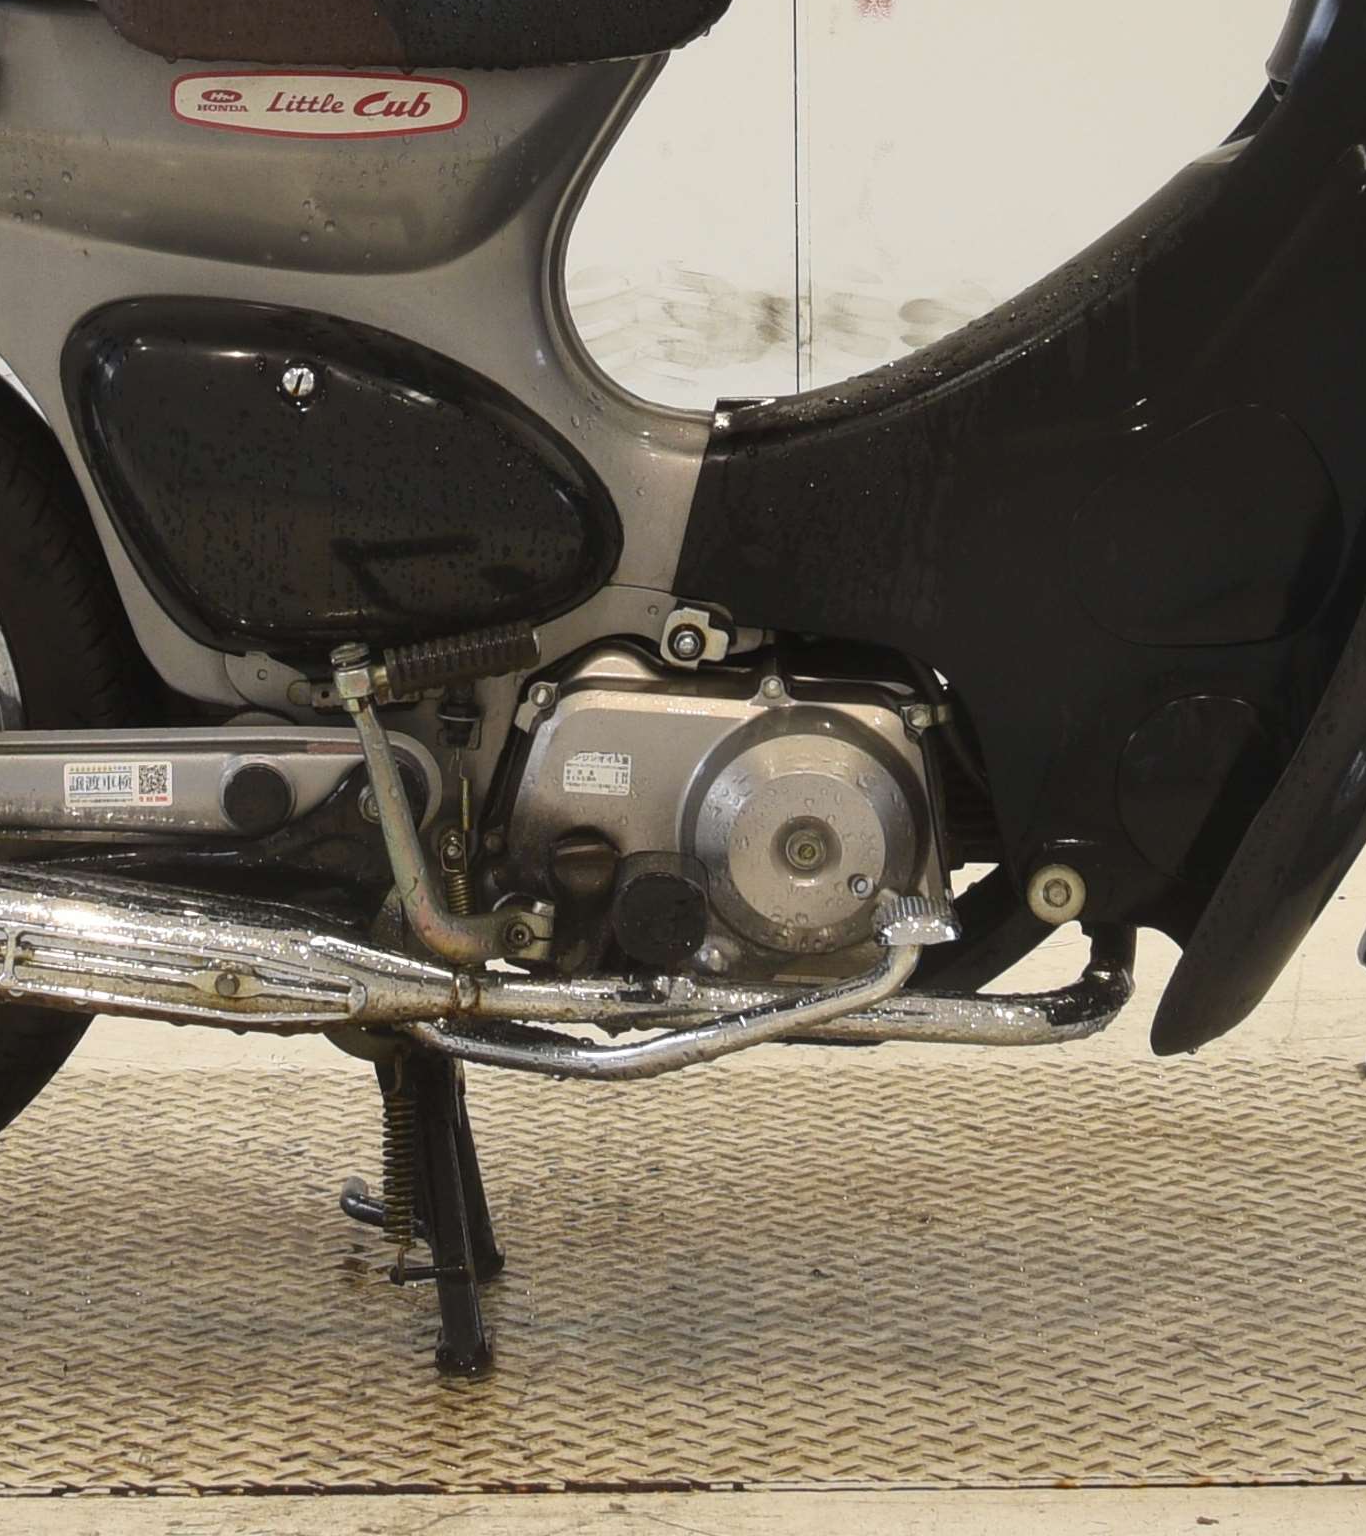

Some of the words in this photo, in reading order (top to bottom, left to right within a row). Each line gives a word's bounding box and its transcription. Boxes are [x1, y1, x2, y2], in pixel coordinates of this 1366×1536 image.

[197, 104, 248, 113] HONDA
[266, 91, 345, 113] Little
[353, 91, 432, 118] Cub
